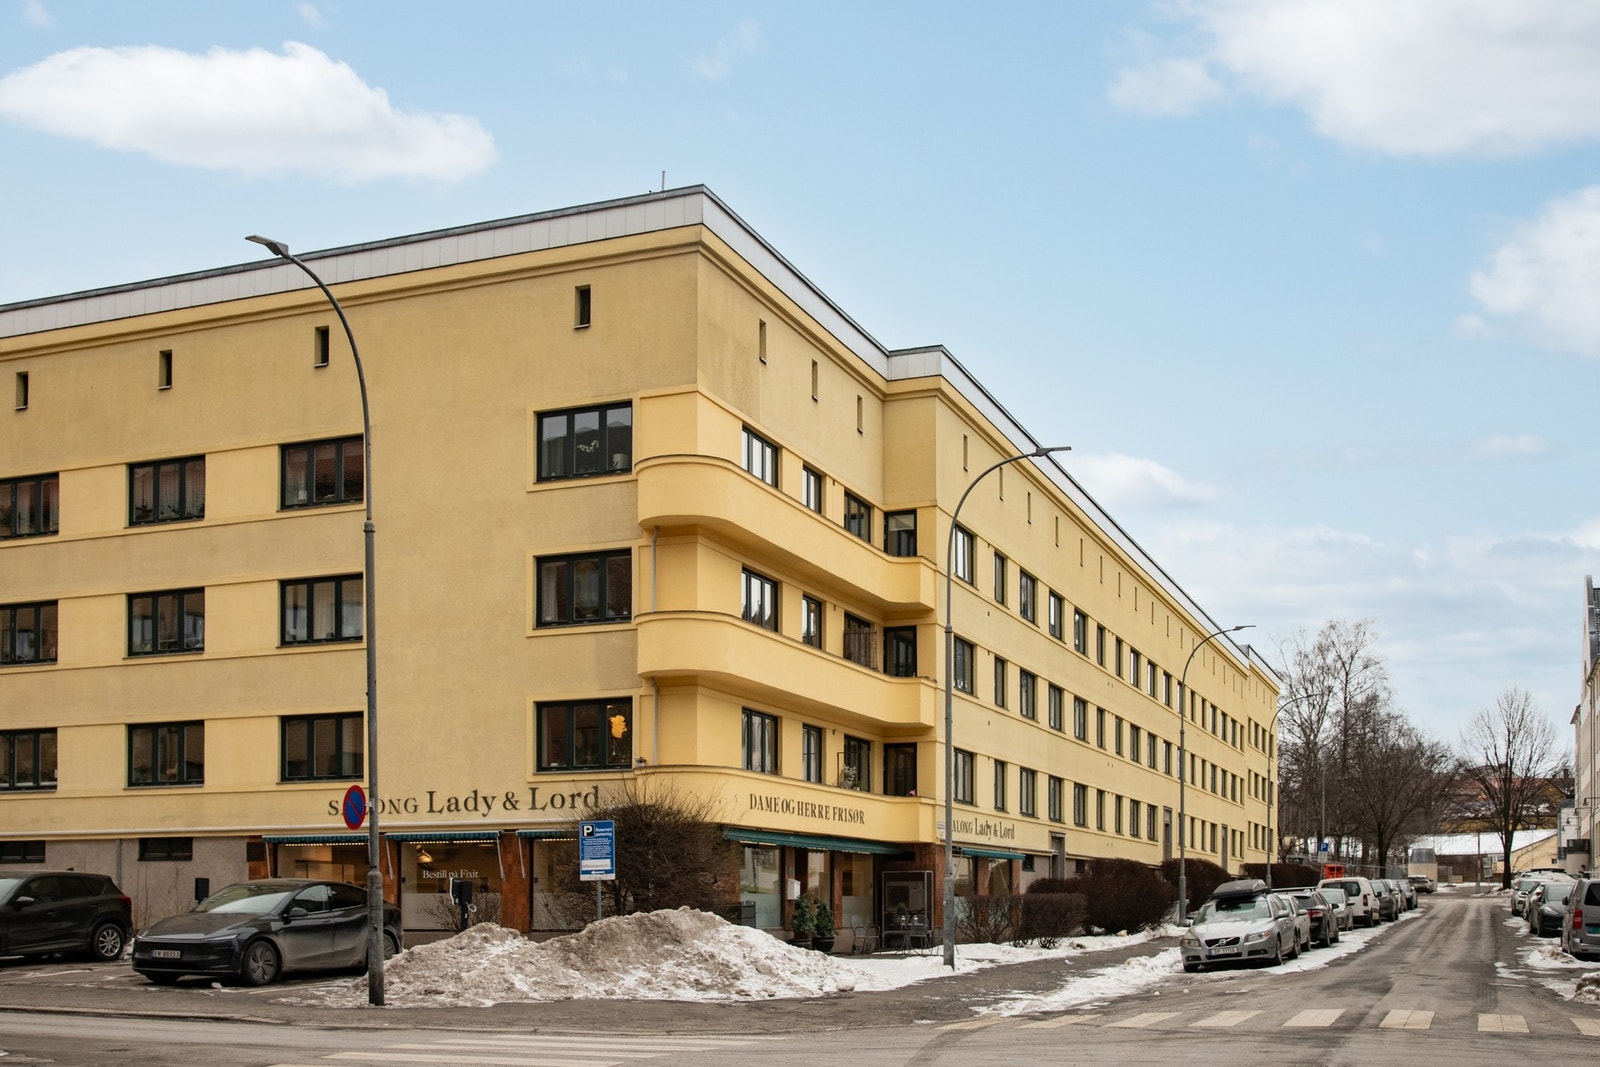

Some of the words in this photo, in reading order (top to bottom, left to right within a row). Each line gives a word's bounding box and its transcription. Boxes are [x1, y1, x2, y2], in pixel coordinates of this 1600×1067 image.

[328, 797, 419, 816] SONG
[426, 789, 497, 817] Lady
[502, 790, 520, 811] &
[528, 784, 600, 812] Lord
[749, 793, 780, 813] DAME
[781, 798, 796, 815] OG
[797, 800, 831, 821] HERRE
[583, 825, 593, 836] P
[951, 819, 973, 834] ALONG
[974, 817, 993, 840] Lady
[993, 822, 998, 837] &
[999, 821, 1015, 840] Lord
[422, 870, 447, 879] Bestill
[460, 869, 479, 878] Fixit
